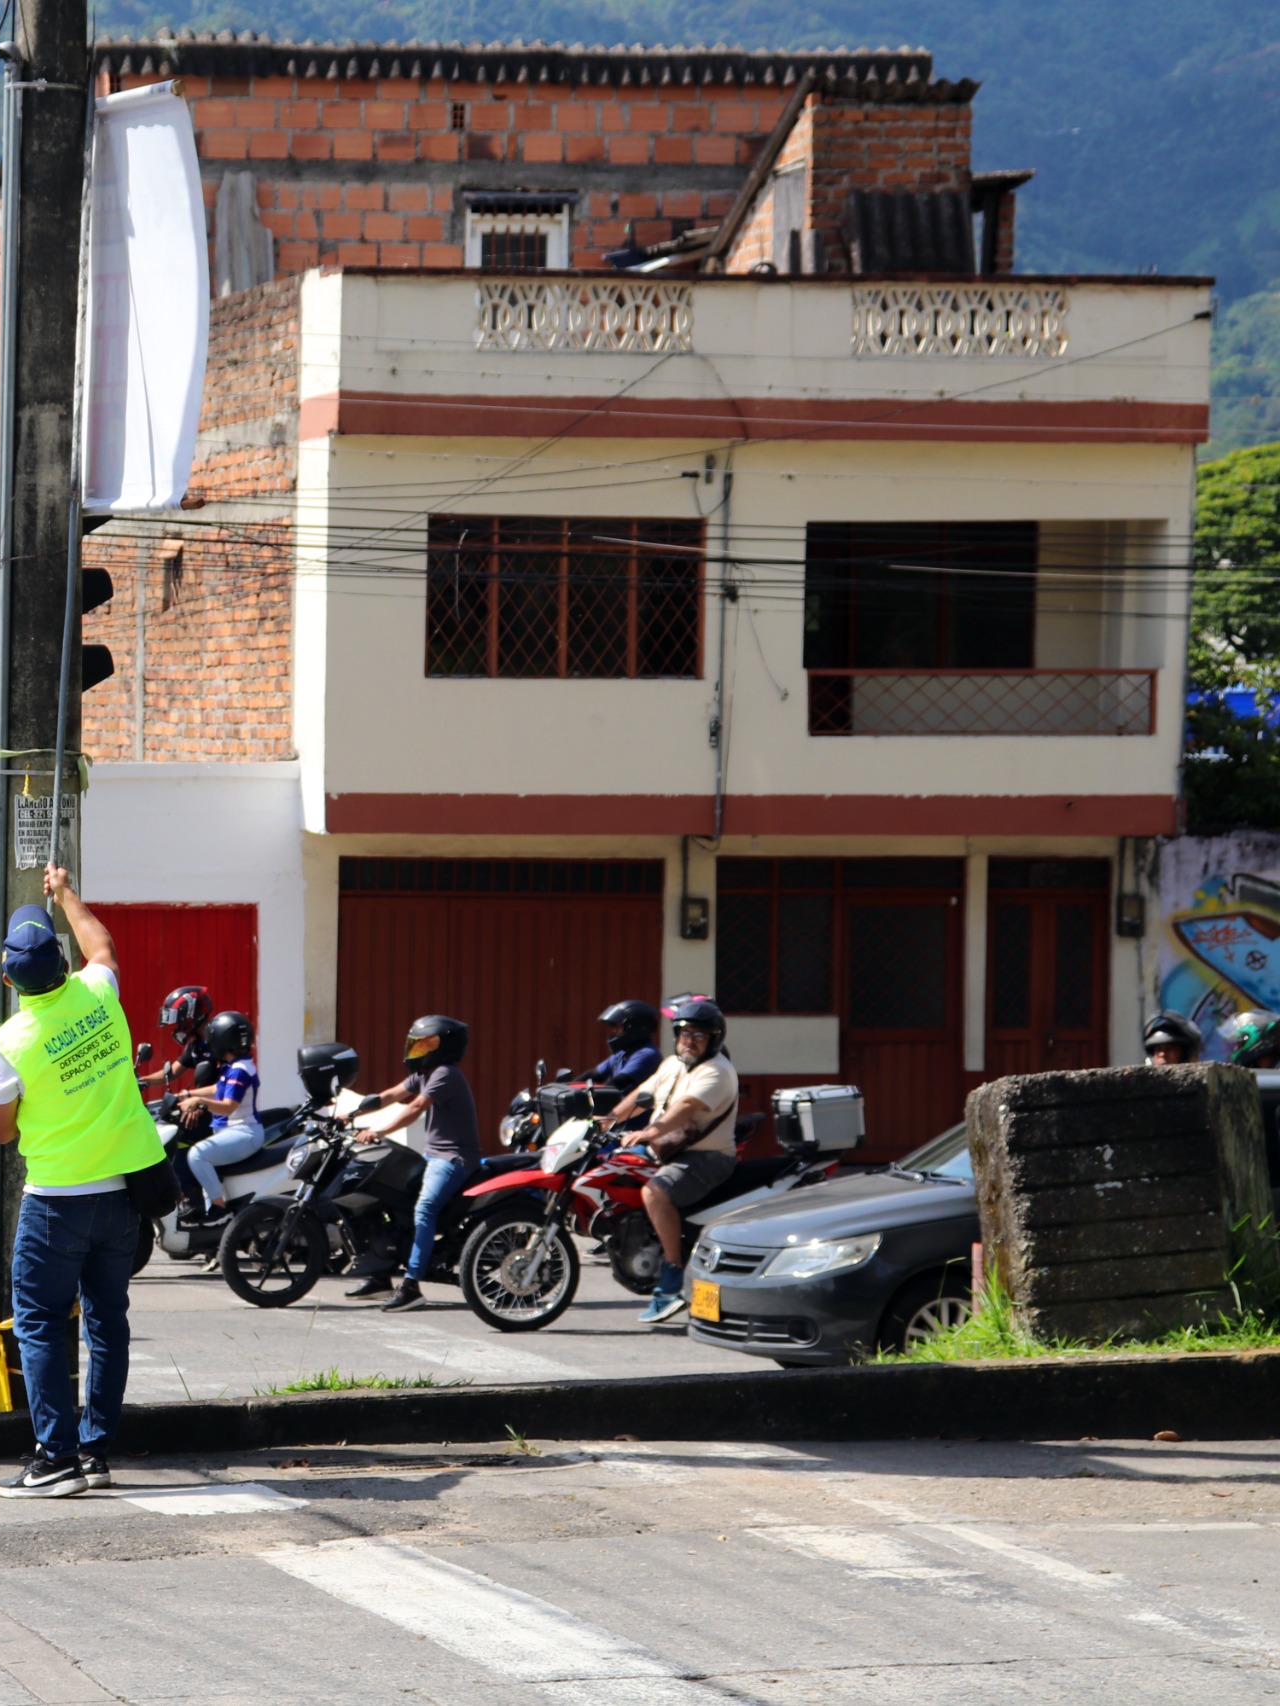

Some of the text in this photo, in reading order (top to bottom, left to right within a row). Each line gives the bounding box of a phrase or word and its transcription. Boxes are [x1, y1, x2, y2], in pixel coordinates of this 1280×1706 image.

[44, 1022, 79, 1056] ALCALDÍA
[75, 1019, 88, 1036] DE
[59, 1031, 114, 1070] DEFENSORES DEL
[60, 1040, 120, 1082] ESPACIO PÚBLICO
